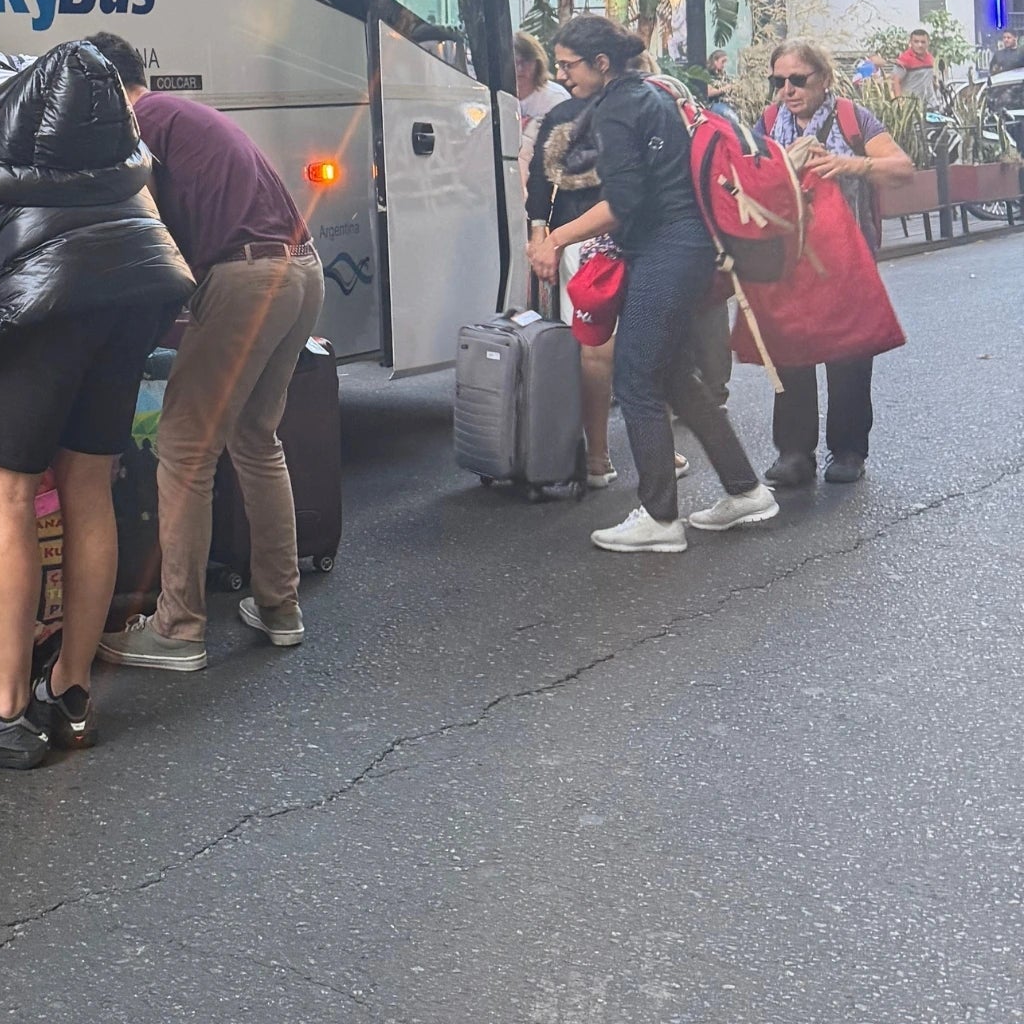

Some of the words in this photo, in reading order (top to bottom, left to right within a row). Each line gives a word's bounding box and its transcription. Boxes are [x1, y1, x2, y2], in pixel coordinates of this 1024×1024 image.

[135, 47, 160, 69] NA
[156, 77, 197, 89] COLCAR
[319, 222, 360, 242] Argentina
